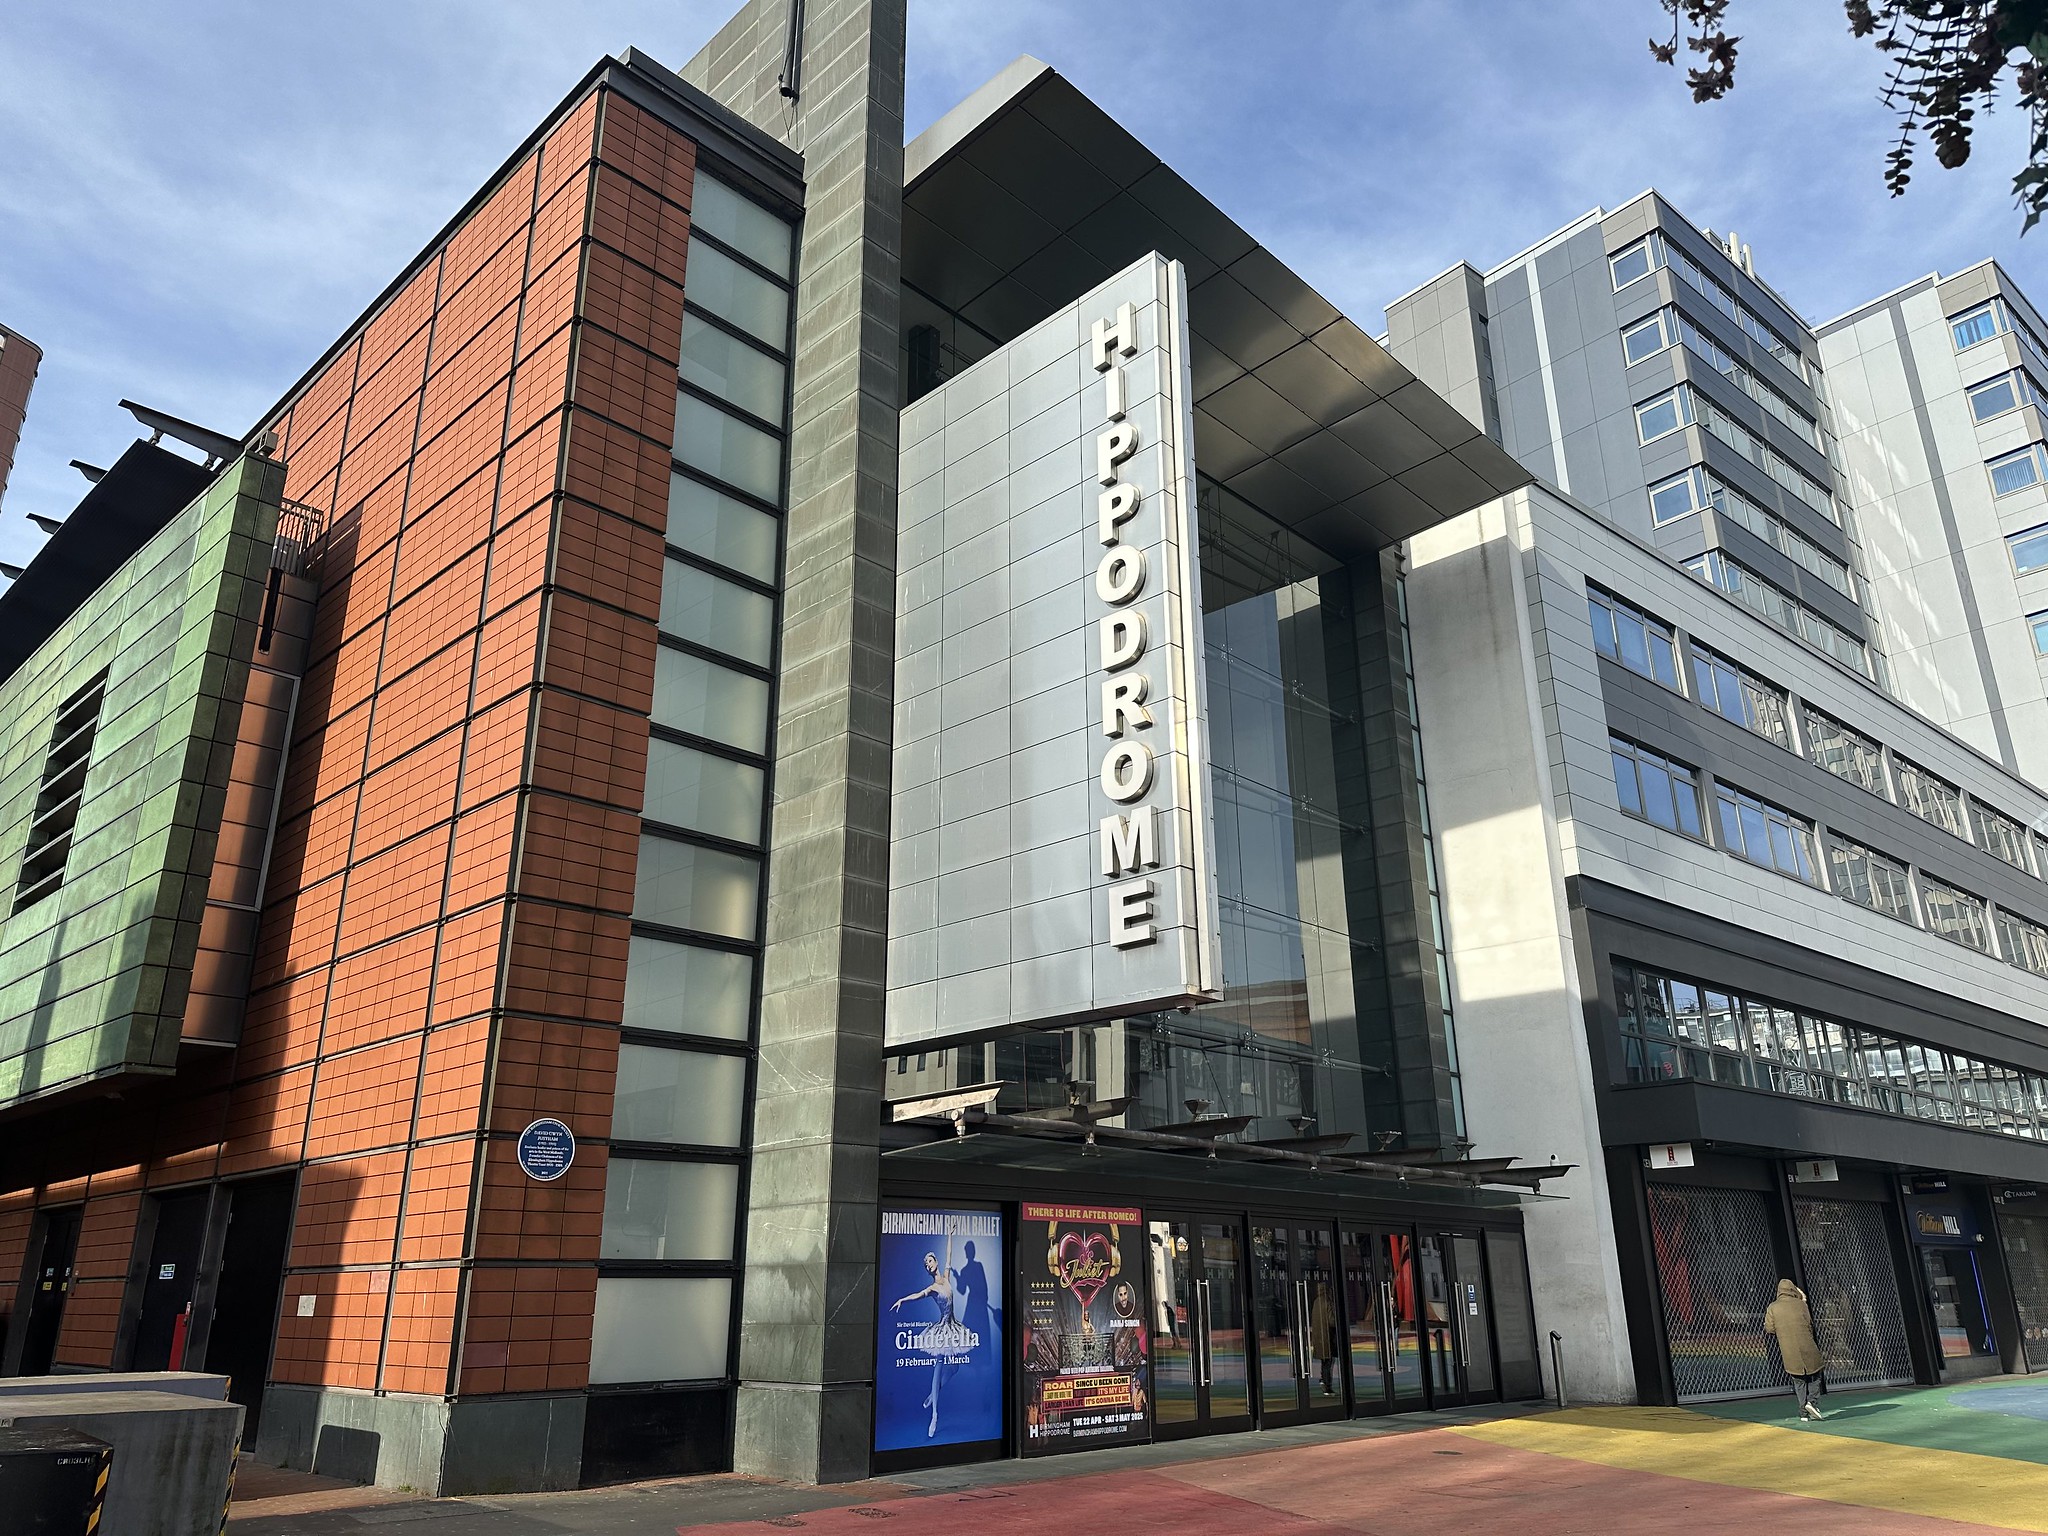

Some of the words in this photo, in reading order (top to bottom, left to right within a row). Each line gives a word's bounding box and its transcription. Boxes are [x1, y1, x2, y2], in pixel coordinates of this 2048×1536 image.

[1092, 301, 1159, 951] HIPPODROME
[2011, 1190, 2037, 1198] TAKUMI
[1028, 1207, 1055, 1217] THERE
[1055, 1208, 1064, 1217] IS
[1065, 1209, 1081, 1218] LIFE
[1082, 1210, 1107, 1220] AFTER
[1108, 1211, 1137, 1221] ROMEO!
[881, 1212, 943, 1235] BIRMINGHAM
[944, 1214, 971, 1236] ROYAL
[972, 1216, 1000, 1237] BALLET
[1942, 1215, 1961, 1235] HILL
[1060, 1258, 1110, 1288] Juliet
[1125, 1319, 1140, 1327] SINGH
[895, 1329, 980, 1350] Cinderella
[896, 1358, 904, 1367] 19
[905, 1357, 938, 1367] February
[949, 1355, 970, 1364] March
[1045, 1382, 1073, 1390] ROAR
[1098, 1387, 1108, 1395] IT'S
[1109, 1386, 1119, 1394] MY
[1119, 1385, 1130, 1393] LIFE
[1086, 1397, 1095, 1405] IT'S
[1040, 1421, 1071, 1430] BIRMINGHAM
[1073, 1418, 1082, 1427] TUE
[1083, 1417, 1090, 1425] 22
[1090, 1416, 1102, 1425] APR
[1104, 1414, 1115, 1423] SAT
[1119, 1413, 1130, 1422] MAY
[1040, 1428, 1070, 1438] HIPPODROME
